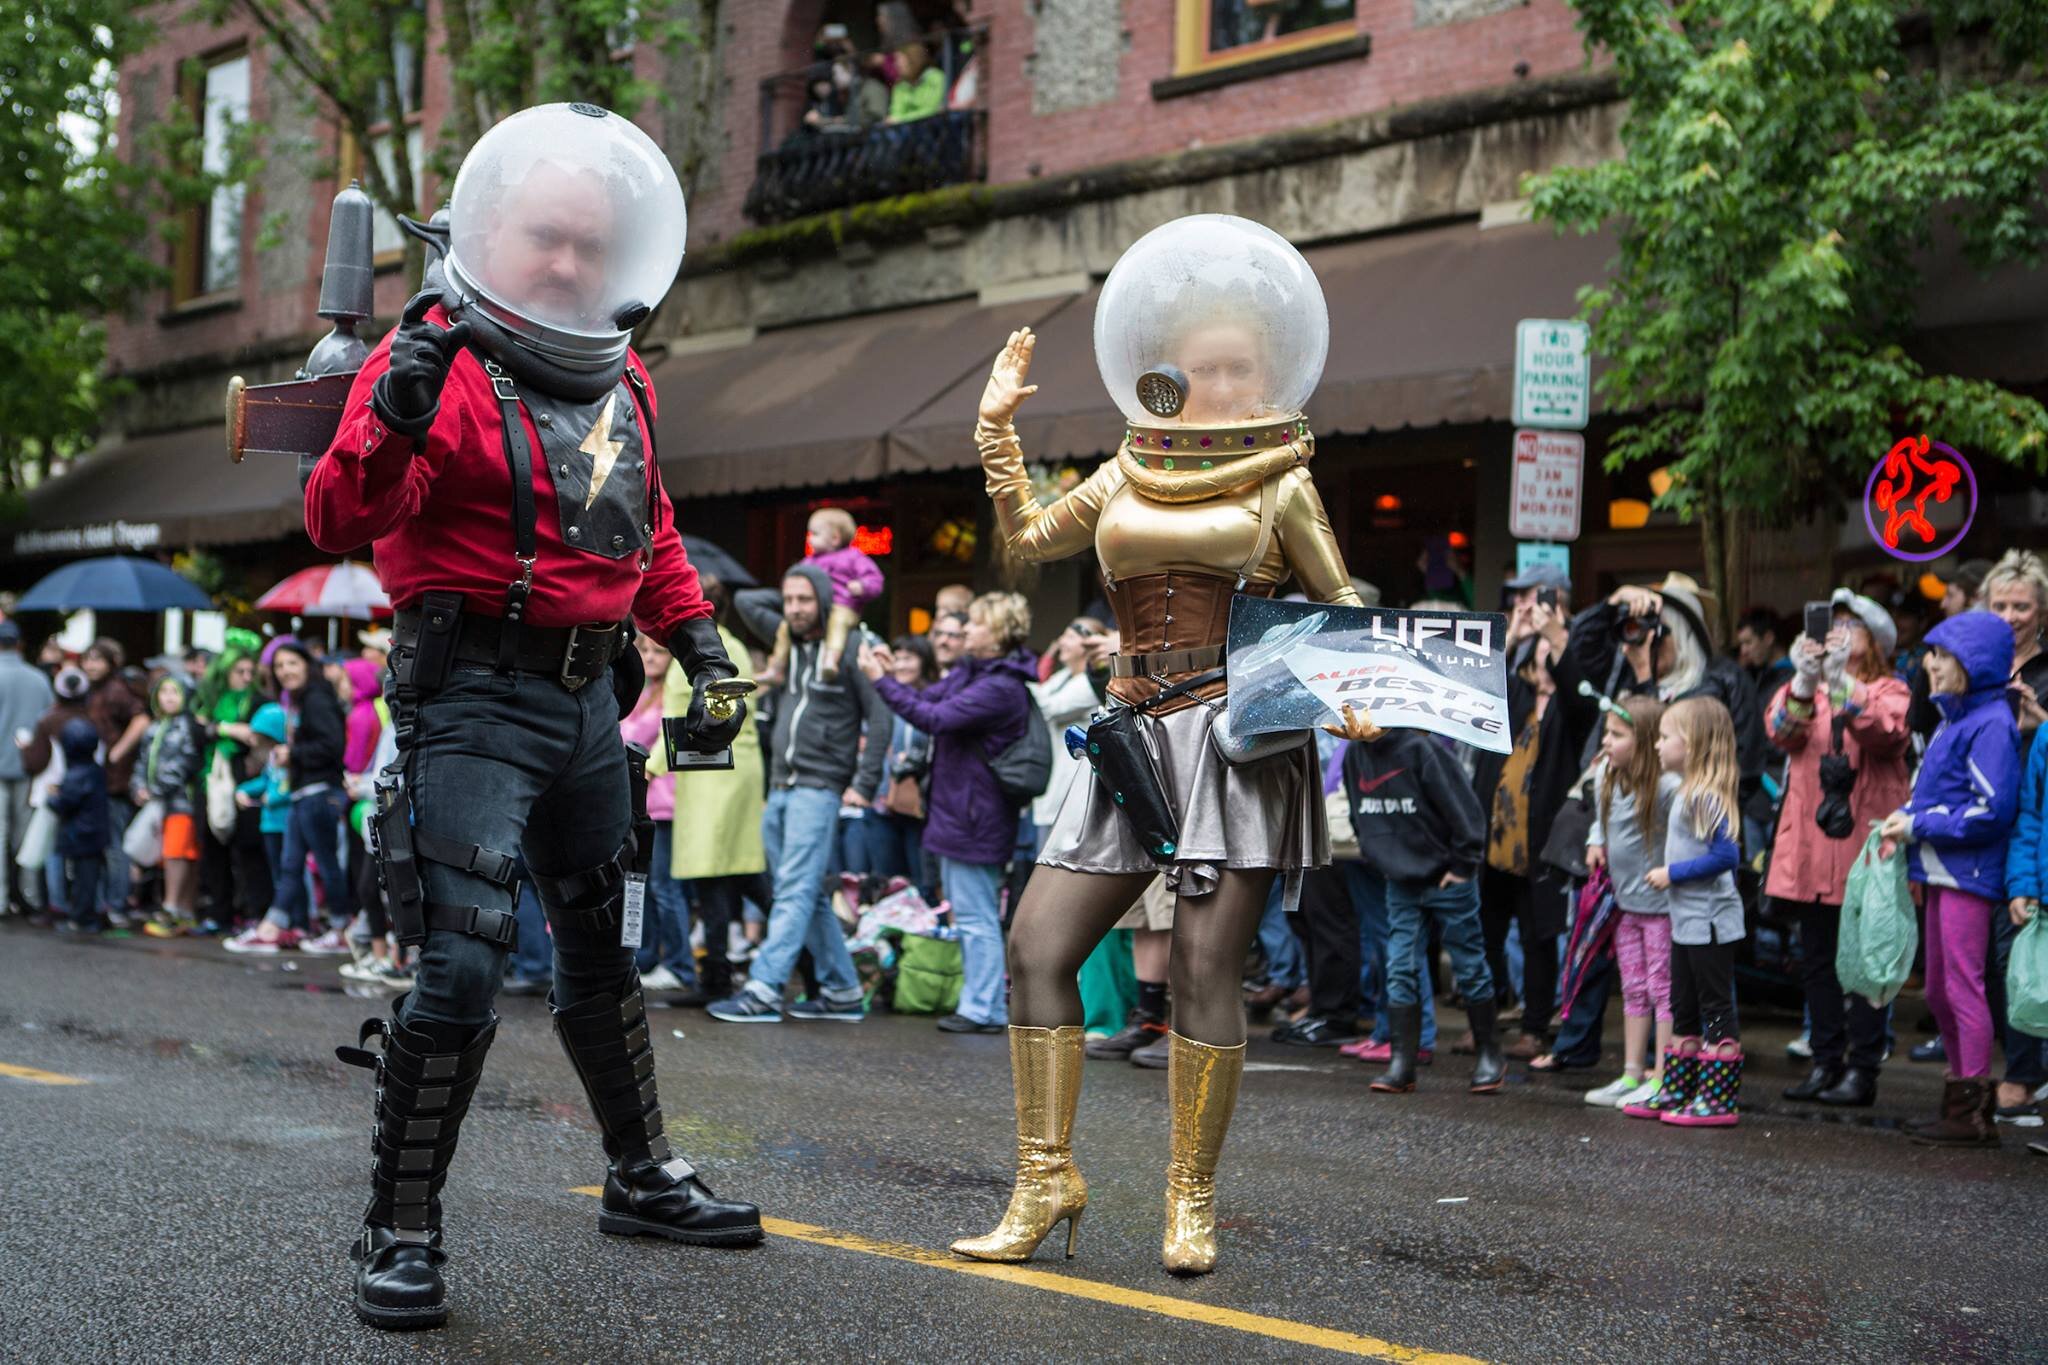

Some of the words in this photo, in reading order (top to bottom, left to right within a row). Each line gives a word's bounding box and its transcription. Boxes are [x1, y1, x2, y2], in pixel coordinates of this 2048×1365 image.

[1541, 330, 1570, 348] TWO
[1533, 352, 1574, 368] HOUR
[1525, 372, 1584, 387] PARKING
[1372, 615, 1491, 657] UFO
[1307, 665, 1398, 682] ALIEN
[1336, 676, 1467, 701] BEST
[1338, 696, 1503, 735] SPACE
